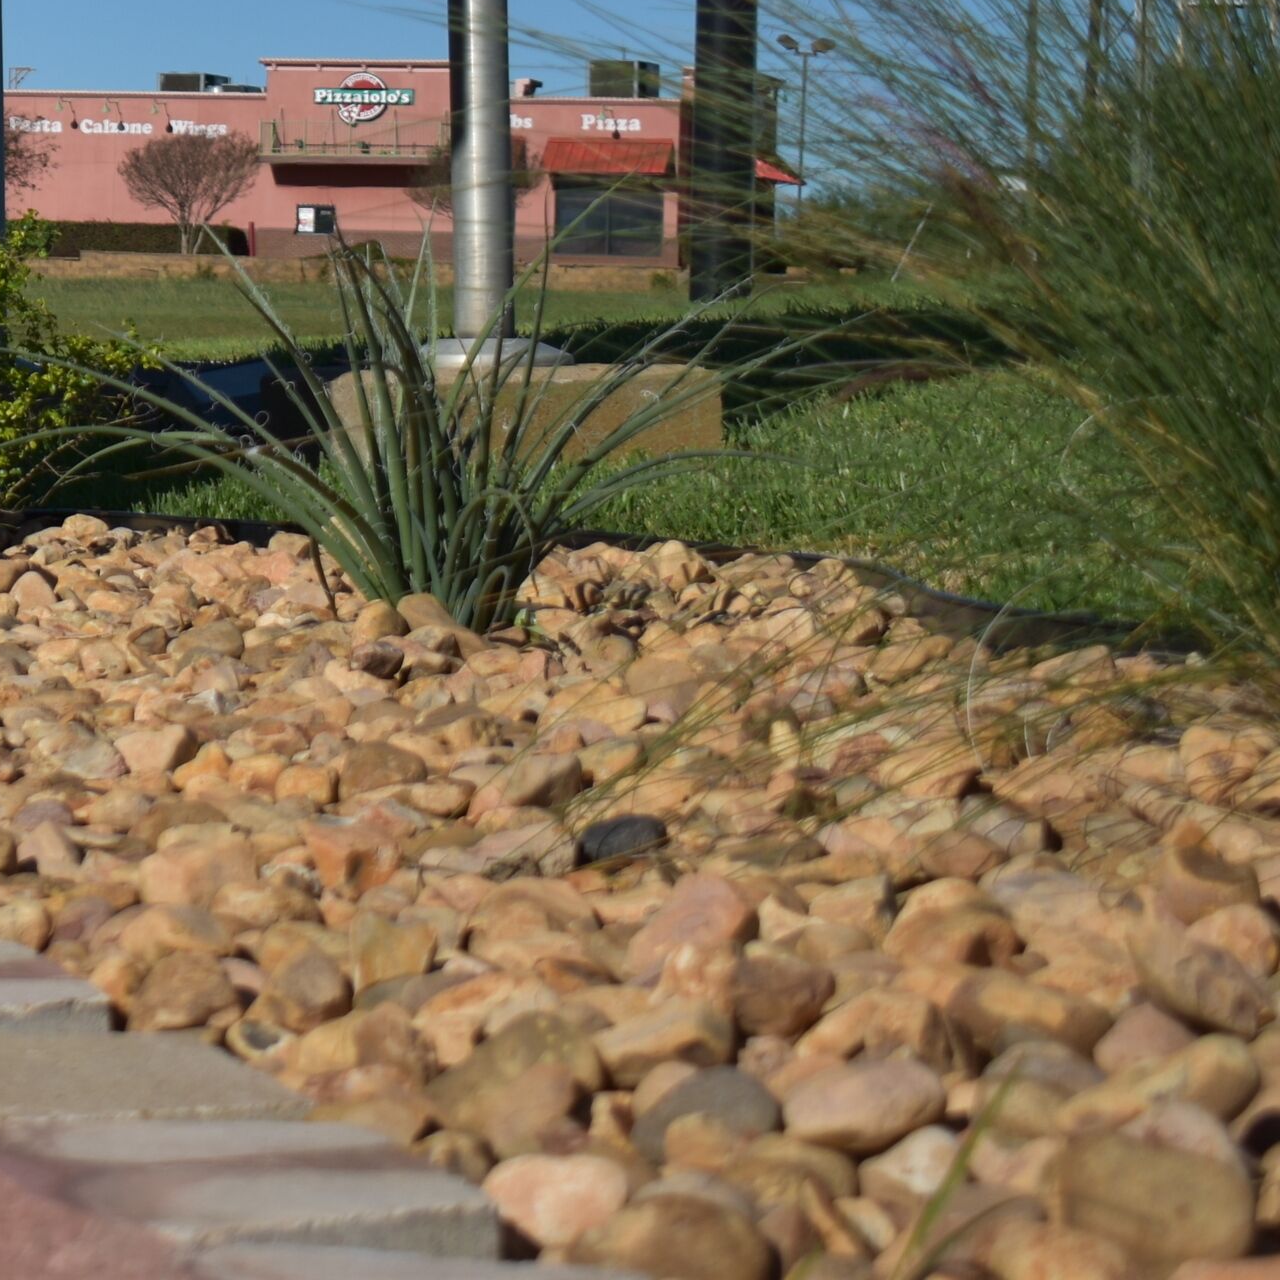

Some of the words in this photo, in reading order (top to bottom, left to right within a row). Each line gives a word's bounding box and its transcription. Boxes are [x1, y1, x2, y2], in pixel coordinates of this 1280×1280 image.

[314, 89, 410, 104] Pizzaiolo's
[10, 116, 63, 133] Pasta
[80, 118, 153, 134] Calzone
[169, 119, 227, 139] Wings
[581, 114, 641, 131] Pizza
